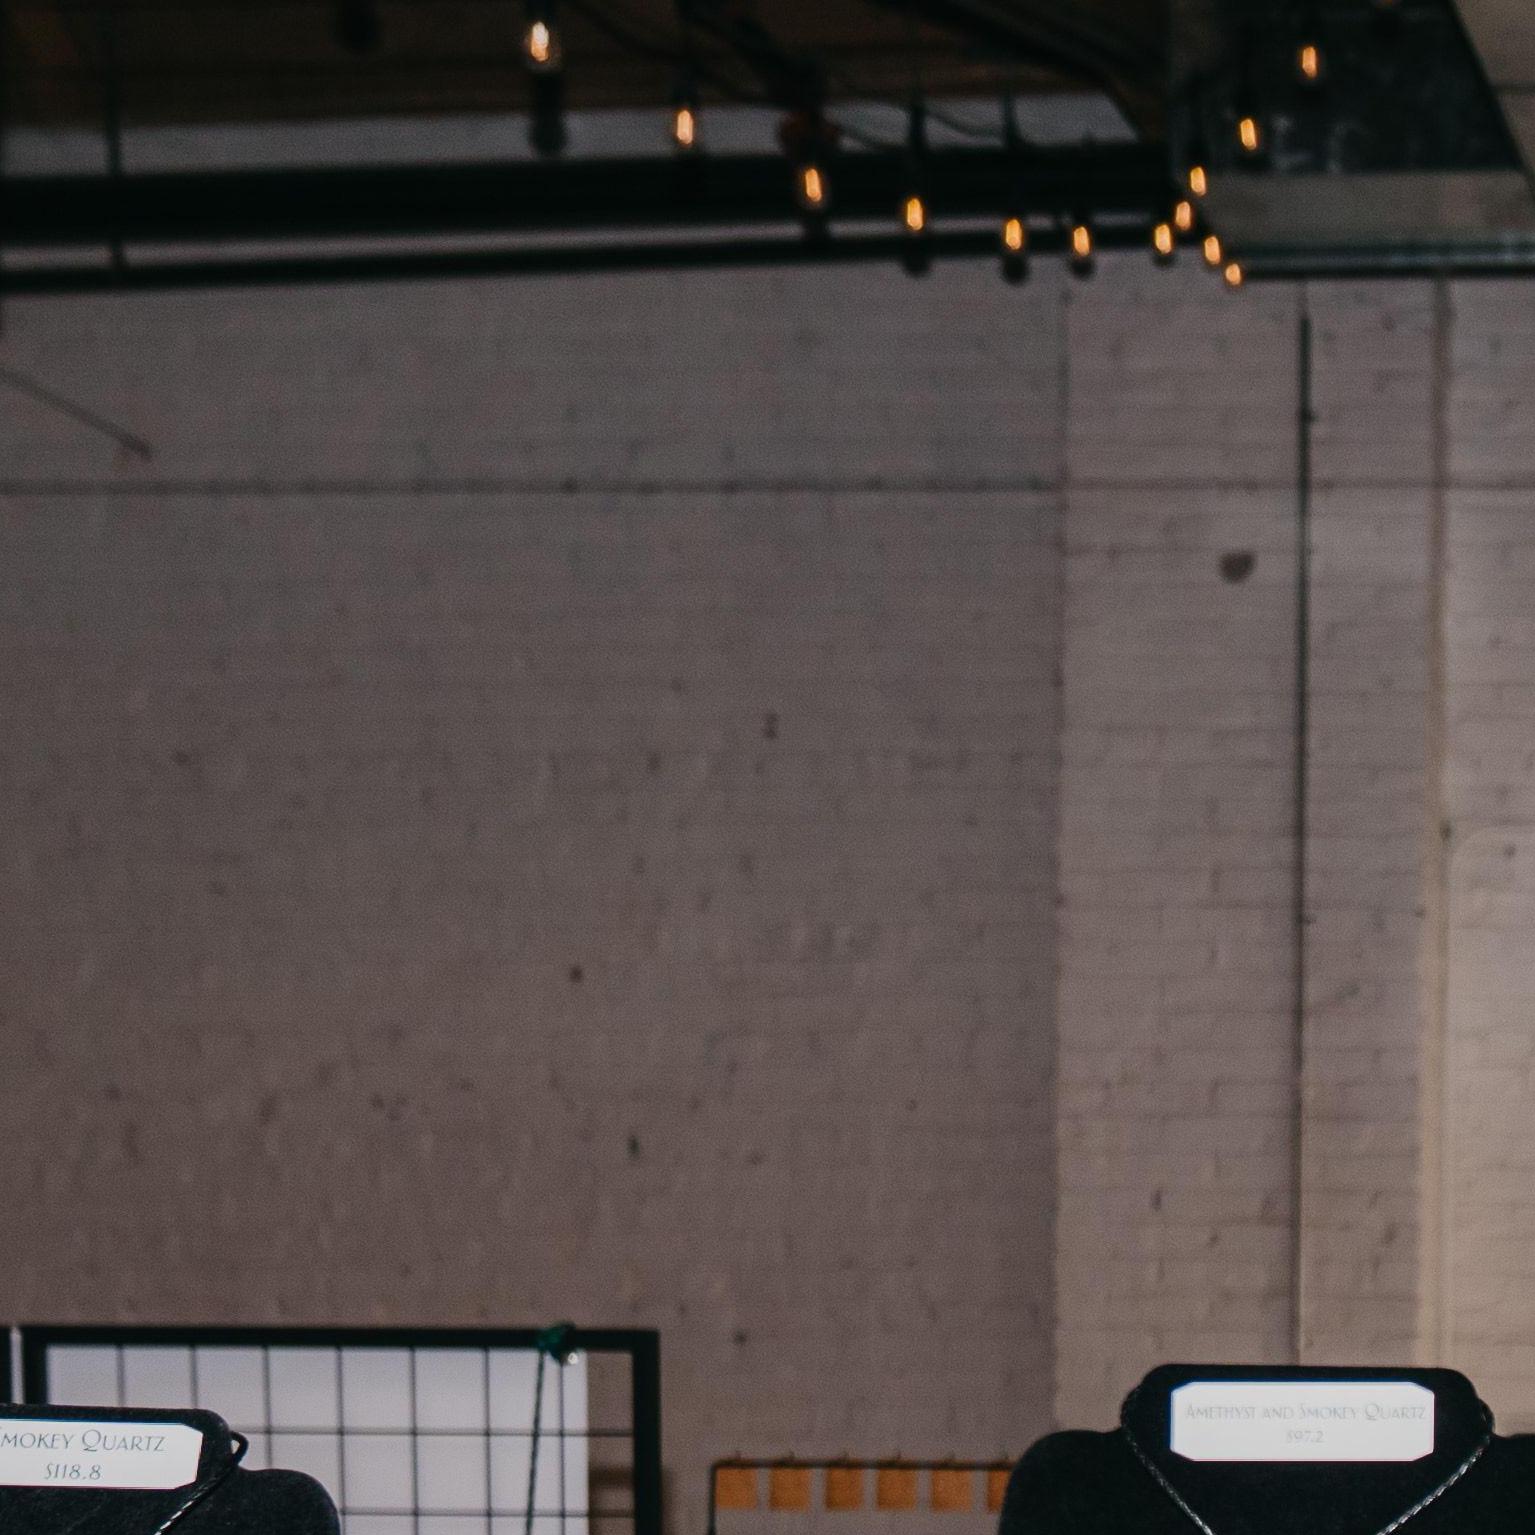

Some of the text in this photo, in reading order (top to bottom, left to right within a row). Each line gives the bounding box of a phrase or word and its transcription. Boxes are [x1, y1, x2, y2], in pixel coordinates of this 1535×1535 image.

[1185, 1402, 1426, 1422] AMETHYST AND SMOKEY QUARTZ
[0, 1429, 167, 1452] MOKEY QUARTZ
[44, 1462, 104, 1481] $118.8
